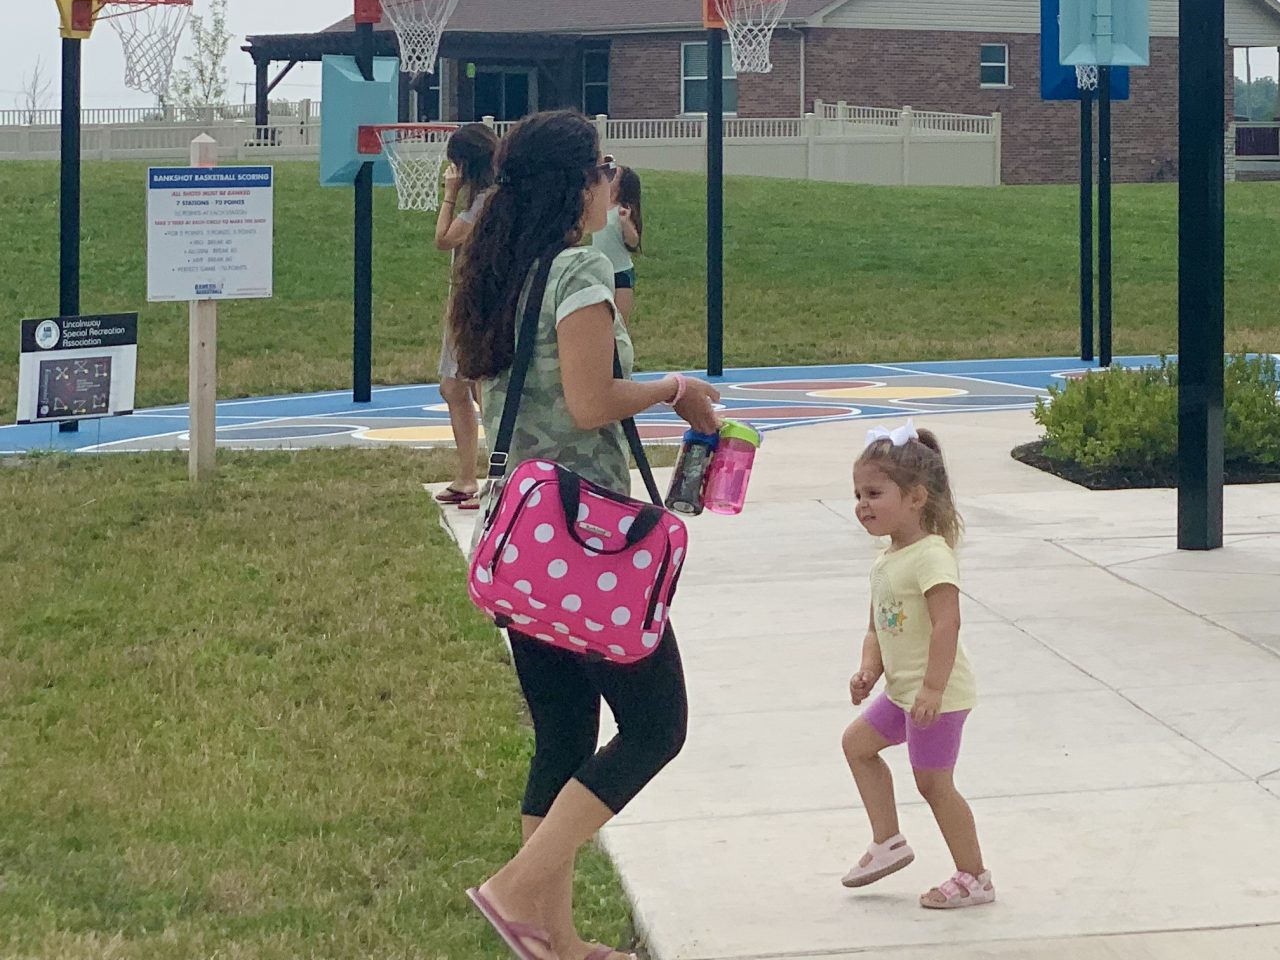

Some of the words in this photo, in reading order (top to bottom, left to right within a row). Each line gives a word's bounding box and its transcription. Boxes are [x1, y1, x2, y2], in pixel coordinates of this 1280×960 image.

[154, 174, 193, 182] BANKSHOT
[194, 173, 236, 181] BASKETBALL
[237, 173, 270, 181] SCORING
[62, 320, 101, 328] Lincolnway
[62, 328, 87, 338] Special
[88, 327, 125, 336] Recreation
[62, 338, 102, 347] Association
